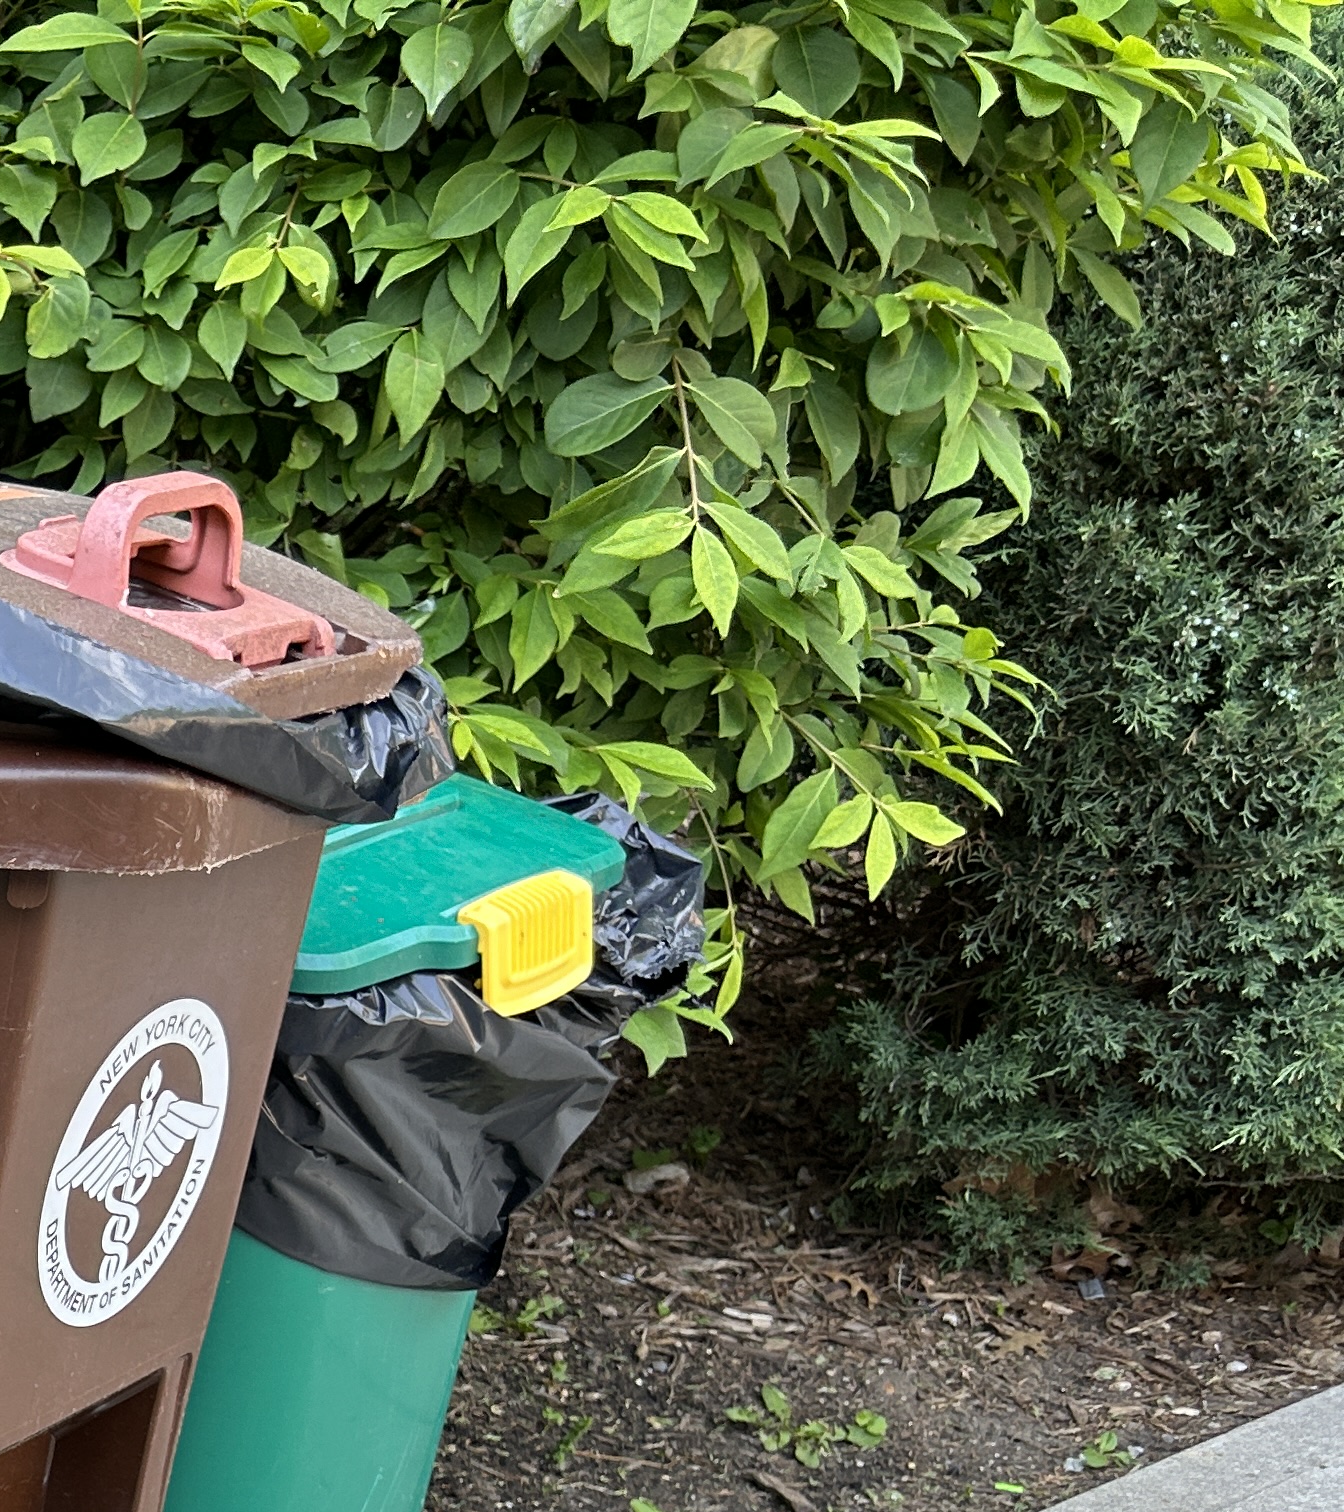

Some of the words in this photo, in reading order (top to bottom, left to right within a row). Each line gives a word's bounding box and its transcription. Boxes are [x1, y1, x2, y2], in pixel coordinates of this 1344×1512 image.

[99, 1036, 140, 1093] NEW
[145, 1013, 190, 1046] YORK
[188, 1018, 216, 1056] CITY
[46, 1217, 99, 1315] DEPARTMENT
[98, 1286, 119, 1310] OF
[120, 1158, 207, 1296] SANITATION
